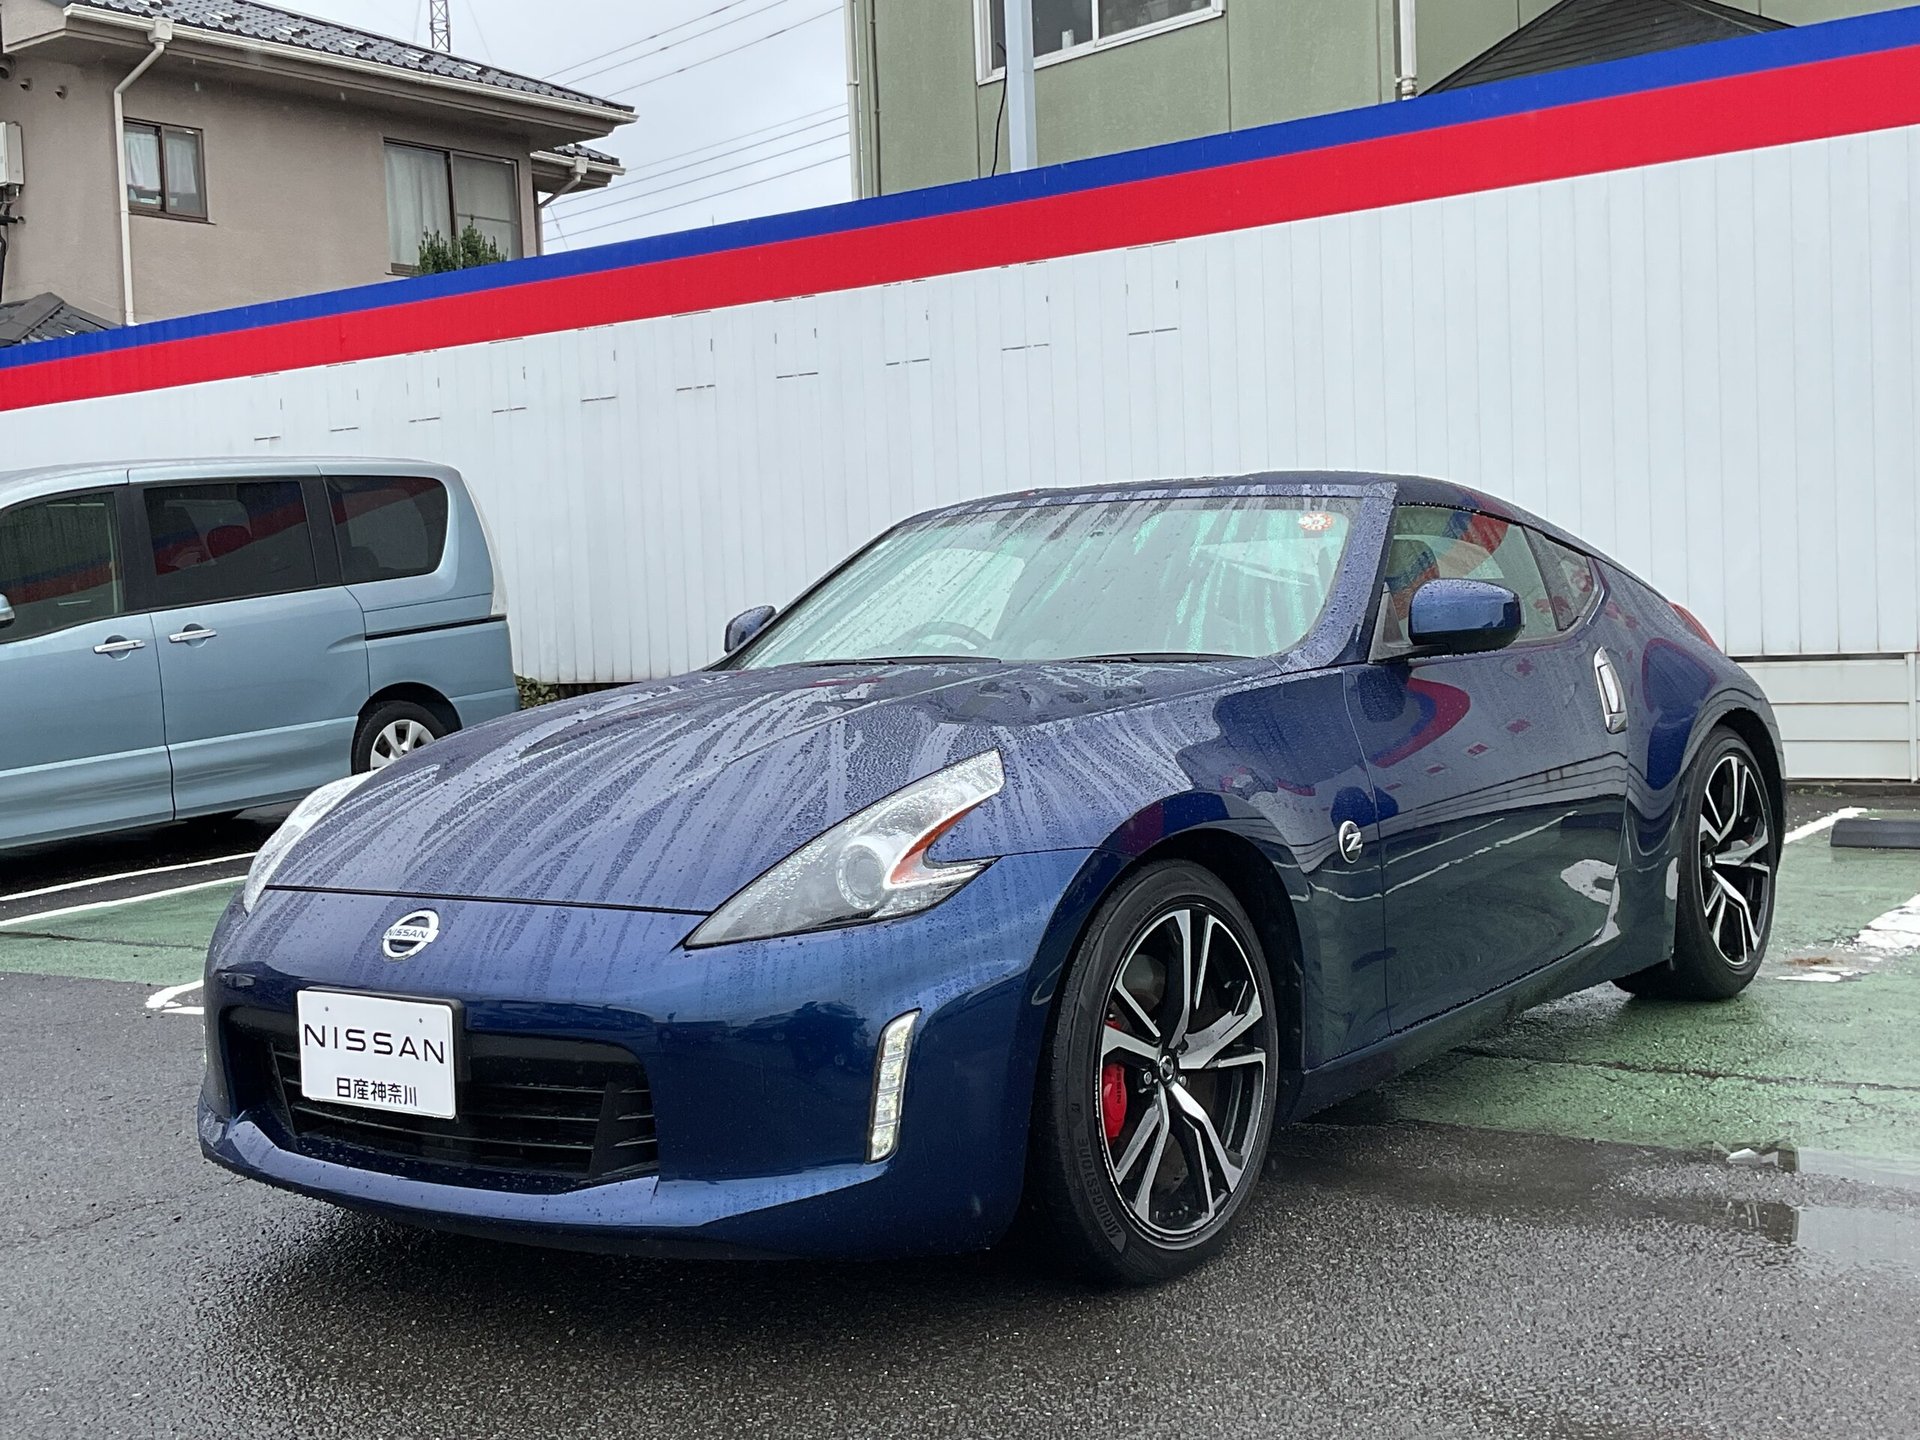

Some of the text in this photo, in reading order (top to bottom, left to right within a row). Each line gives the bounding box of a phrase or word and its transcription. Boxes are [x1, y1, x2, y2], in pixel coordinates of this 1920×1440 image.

[385, 929, 428, 938] NISSAN
[304, 1024, 444, 1064] NISSAN
[336, 1077, 417, 1107] 日産神奈川
